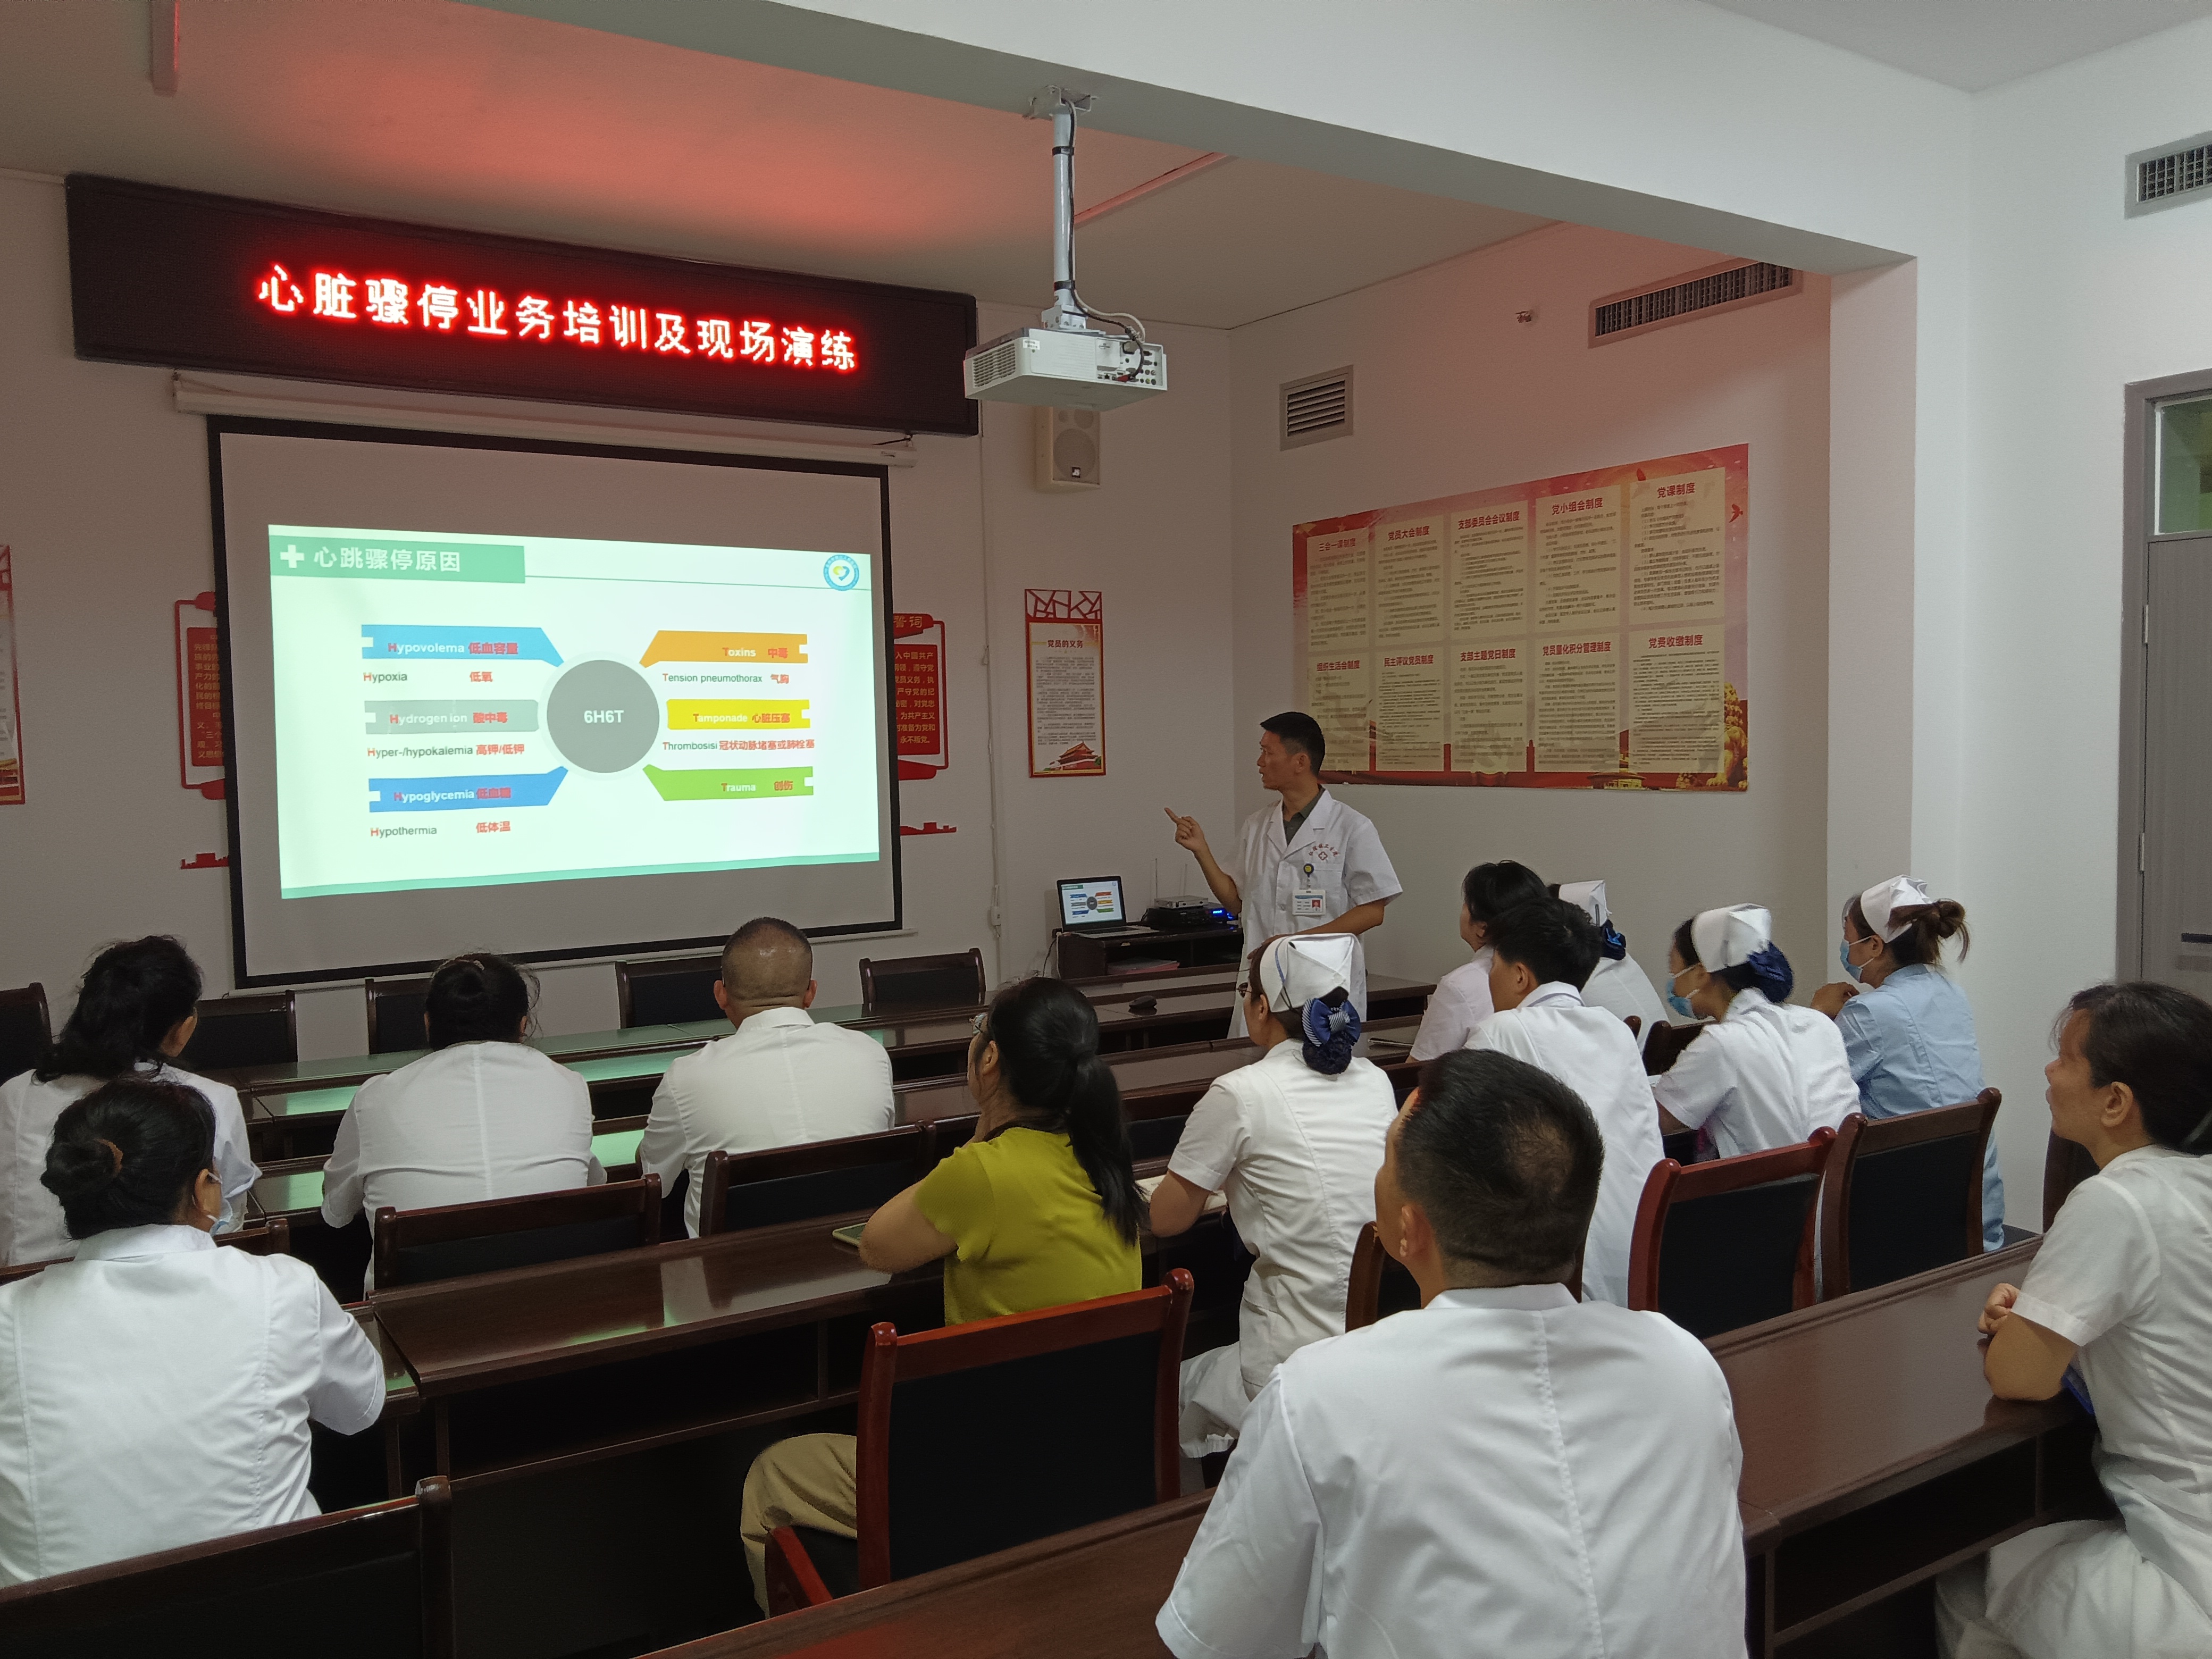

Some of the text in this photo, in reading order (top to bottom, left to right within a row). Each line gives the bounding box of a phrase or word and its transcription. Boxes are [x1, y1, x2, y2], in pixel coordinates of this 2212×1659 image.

[258, 264, 857, 371] 心脏骤停业务培训及现场演练
[1657, 482, 1696, 499] 党课制度
[1552, 497, 1604, 515] 党小组会制度
[1458, 510, 1520, 530] 支部委员会会议制度
[1388, 526, 1430, 541] 党员大会制度
[1319, 538, 1356, 552] 三会一课制度
[314, 545, 460, 572] 心跳骤停原因
[388, 642, 518, 655] Hypovolema 低血容量
[1048, 640, 1083, 648] 党员的义务
[1648, 634, 1703, 649] 党费收缴制度
[723, 647, 789, 658] Toxins 中毒
[1460, 648, 1516, 662] 支部主题党日制度
[1543, 641, 1611, 657] 党员量化积分管理制度
[1317, 659, 1360, 672] 组织生活会制度
[1384, 655, 1434, 667] 民主评议党员制度
[363, 671, 493, 683] Hypoxia 低氧
[663, 673, 790, 685] Tension pneumothorax 气胸
[390, 714, 447, 725] Hydrogen
[449, 714, 467, 723] ion
[584, 710, 624, 724] 6H6T
[693, 713, 790, 723] Tamponade 心脏压塞
[367, 744, 525, 759] Hyper-/hypokalemia 高钾/低钾
[721, 781, 793, 792] Trauma 创伤
[394, 787, 511, 803] Hypoglycemia 低血糖
[371, 821, 510, 839] Hypothermia 低体温
